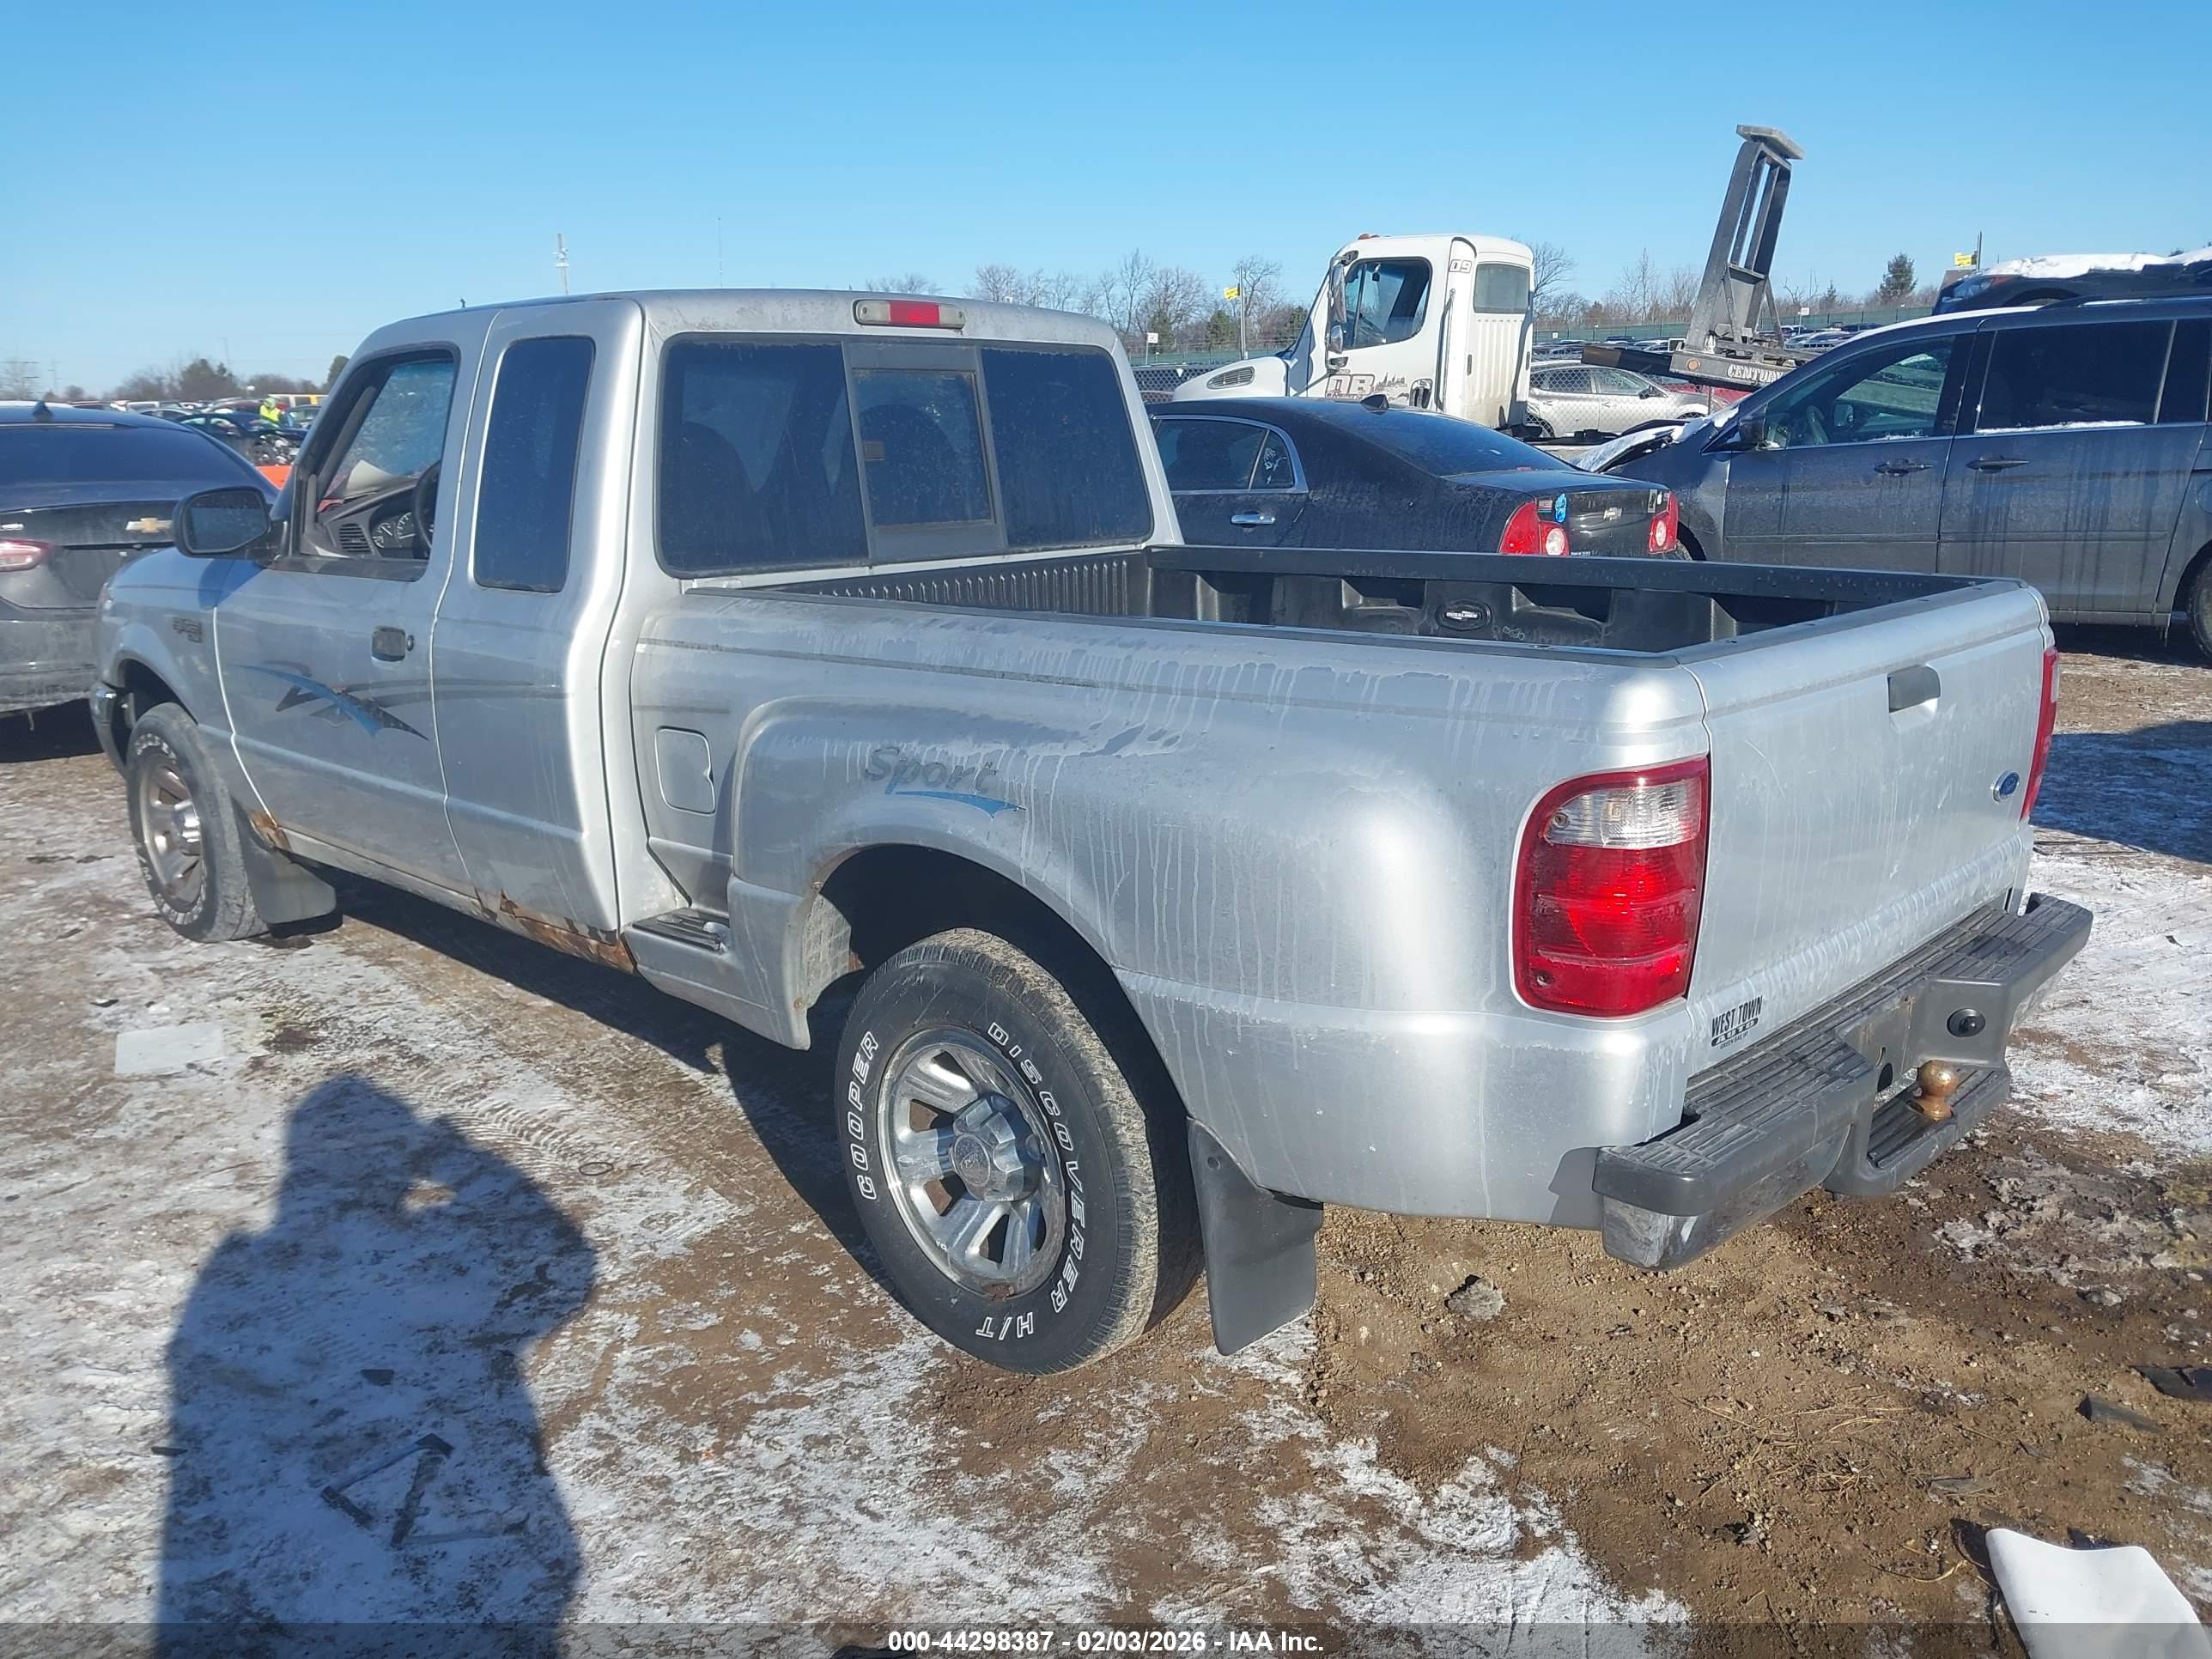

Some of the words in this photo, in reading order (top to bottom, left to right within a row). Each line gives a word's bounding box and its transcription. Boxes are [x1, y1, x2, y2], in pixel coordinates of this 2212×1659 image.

[865, 746, 997, 795] Sport
[1711, 1008, 1736, 1038] WEST
[1739, 995, 1763, 1024] TOWN
[1717, 1020, 1754, 1045] AUTO
[848, 1030, 879, 1201] COOPER
[988, 1021, 1085, 1314] DISCOVERER
[975, 1310, 1035, 1341] H/T
